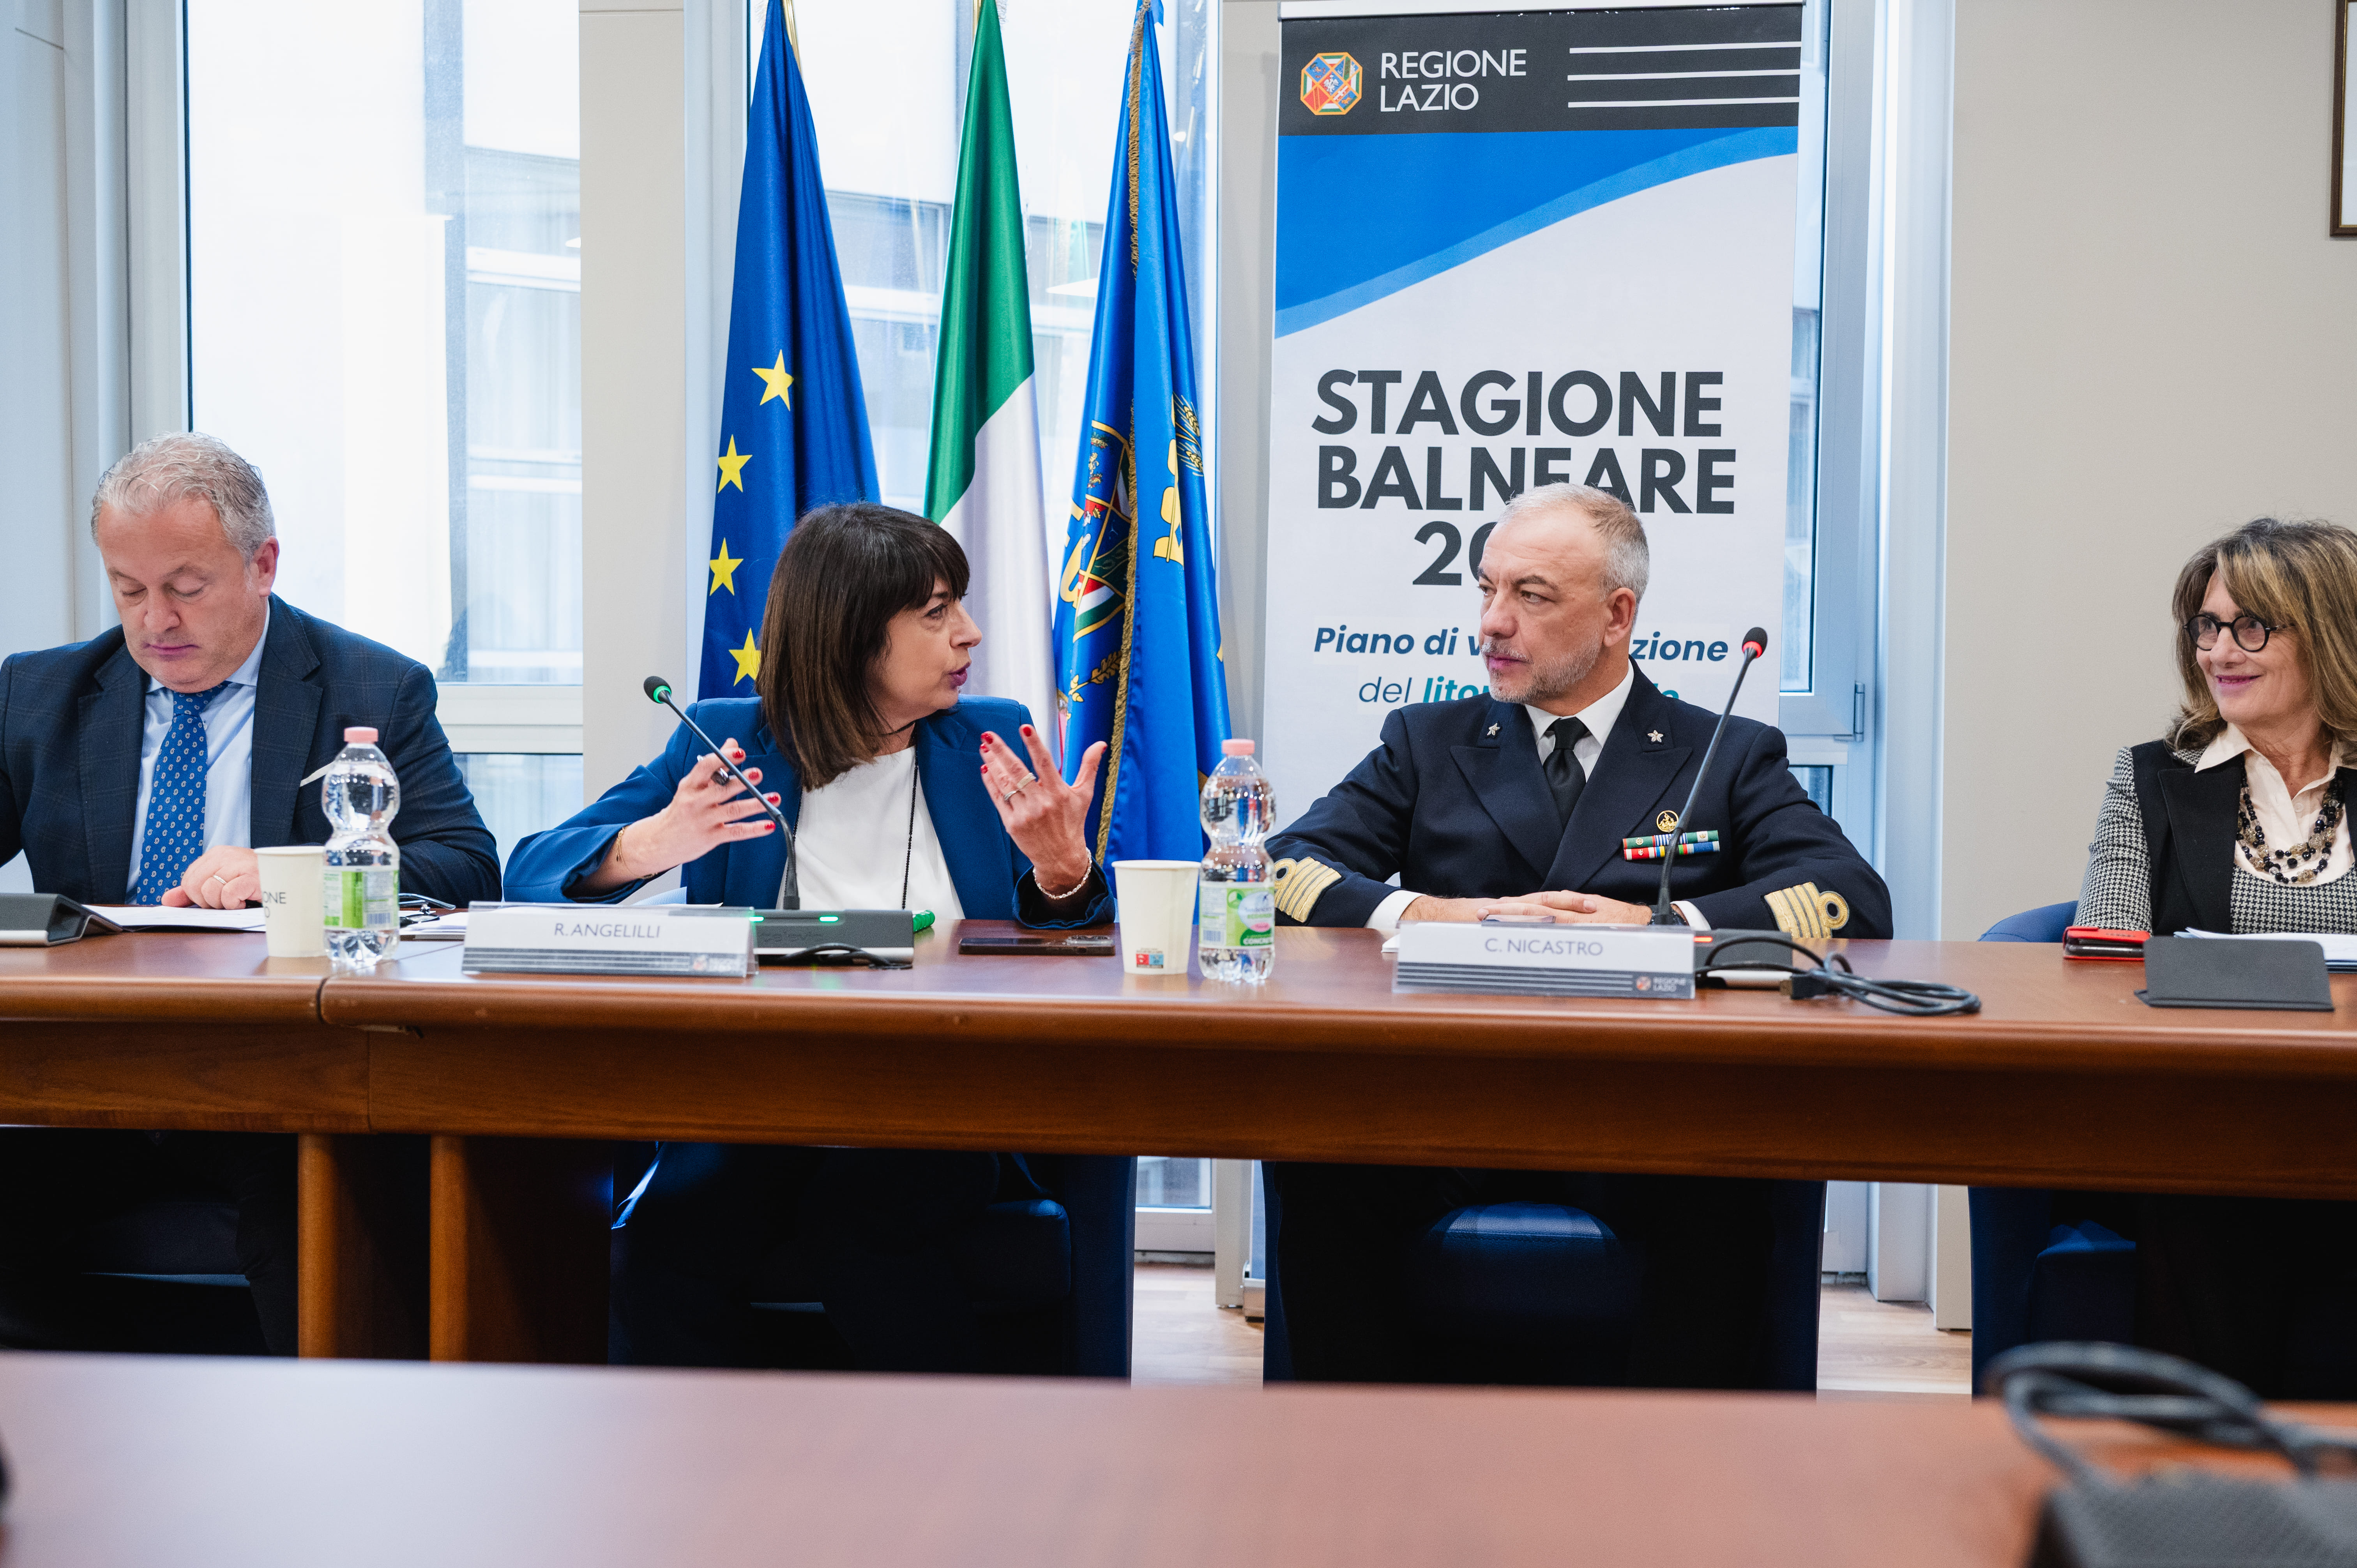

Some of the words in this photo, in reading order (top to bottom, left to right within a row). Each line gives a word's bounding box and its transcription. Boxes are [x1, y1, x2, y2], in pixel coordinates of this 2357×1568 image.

[1381, 49, 1527, 79] REGIONE
[1380, 83, 1479, 112] LAZIO
[1311, 369, 1723, 437] STAGIONE
[1314, 624, 1415, 655] Piano
[1423, 627, 1459, 655] di
[1358, 676, 1413, 703] del
[1484, 938, 1502, 952] C.
[1507, 939, 1603, 956] NICASTRO
